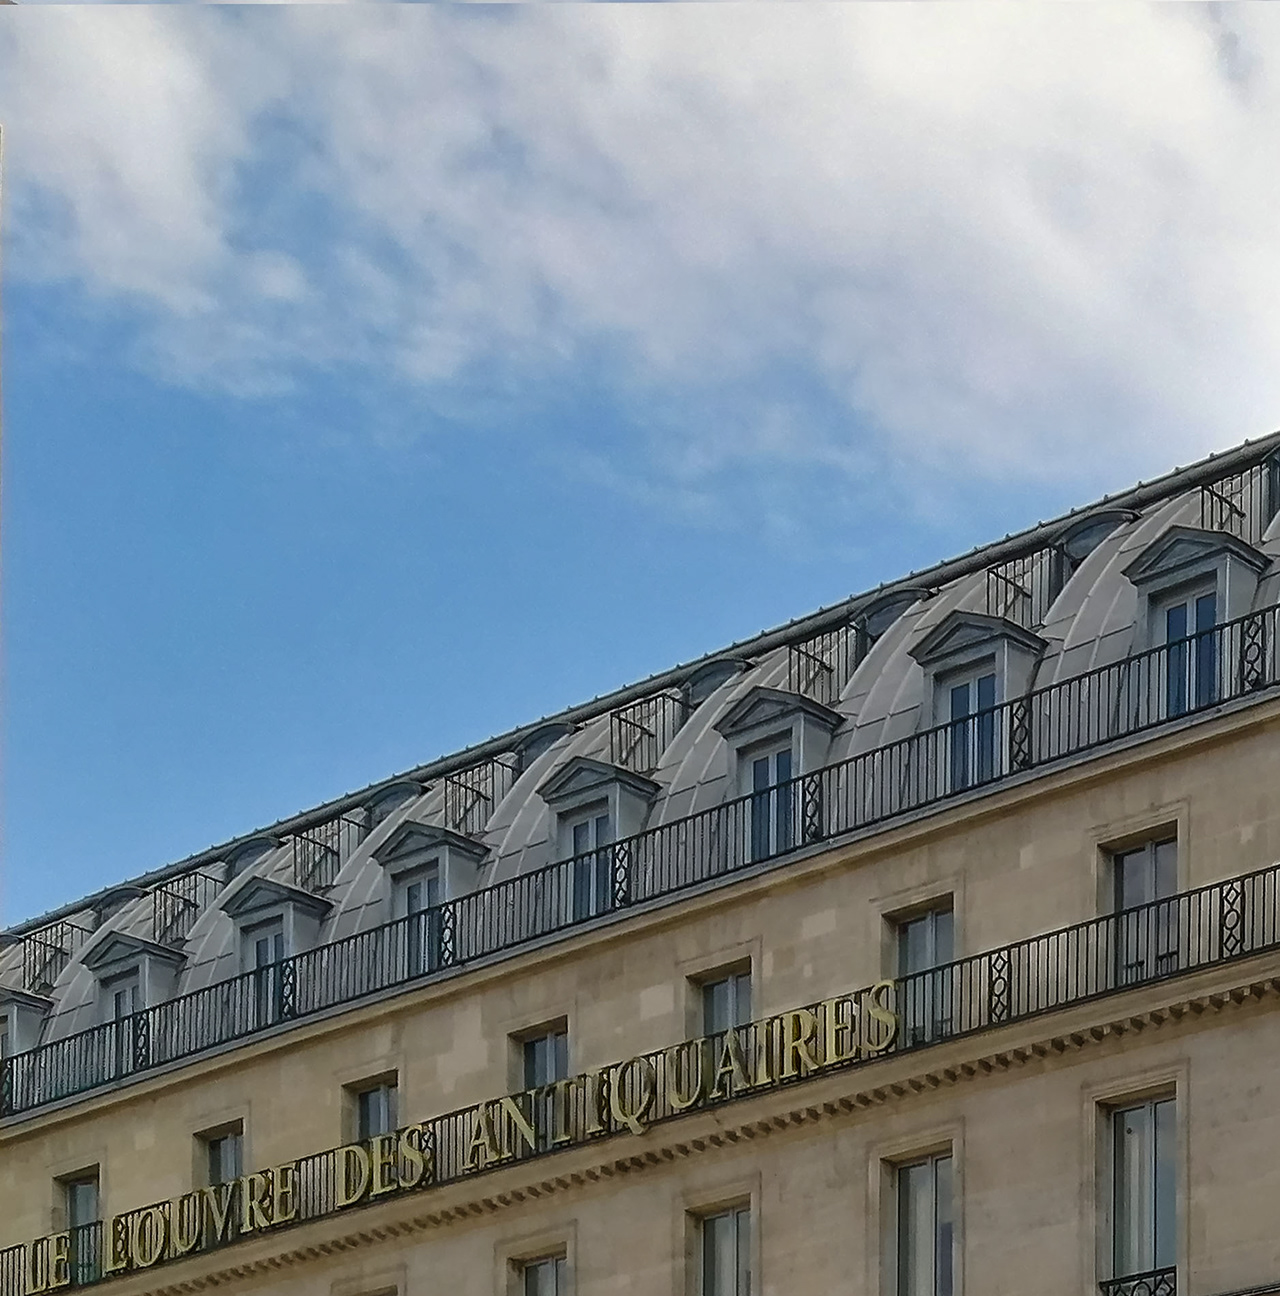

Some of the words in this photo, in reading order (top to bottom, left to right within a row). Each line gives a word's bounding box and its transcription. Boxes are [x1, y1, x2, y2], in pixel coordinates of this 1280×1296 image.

[25, 1231, 72, 1296] LE
[103, 1162, 299, 1275] LOUVRE
[335, 1124, 427, 1209] DES
[461, 979, 900, 1172] ANTIQUAIRES
